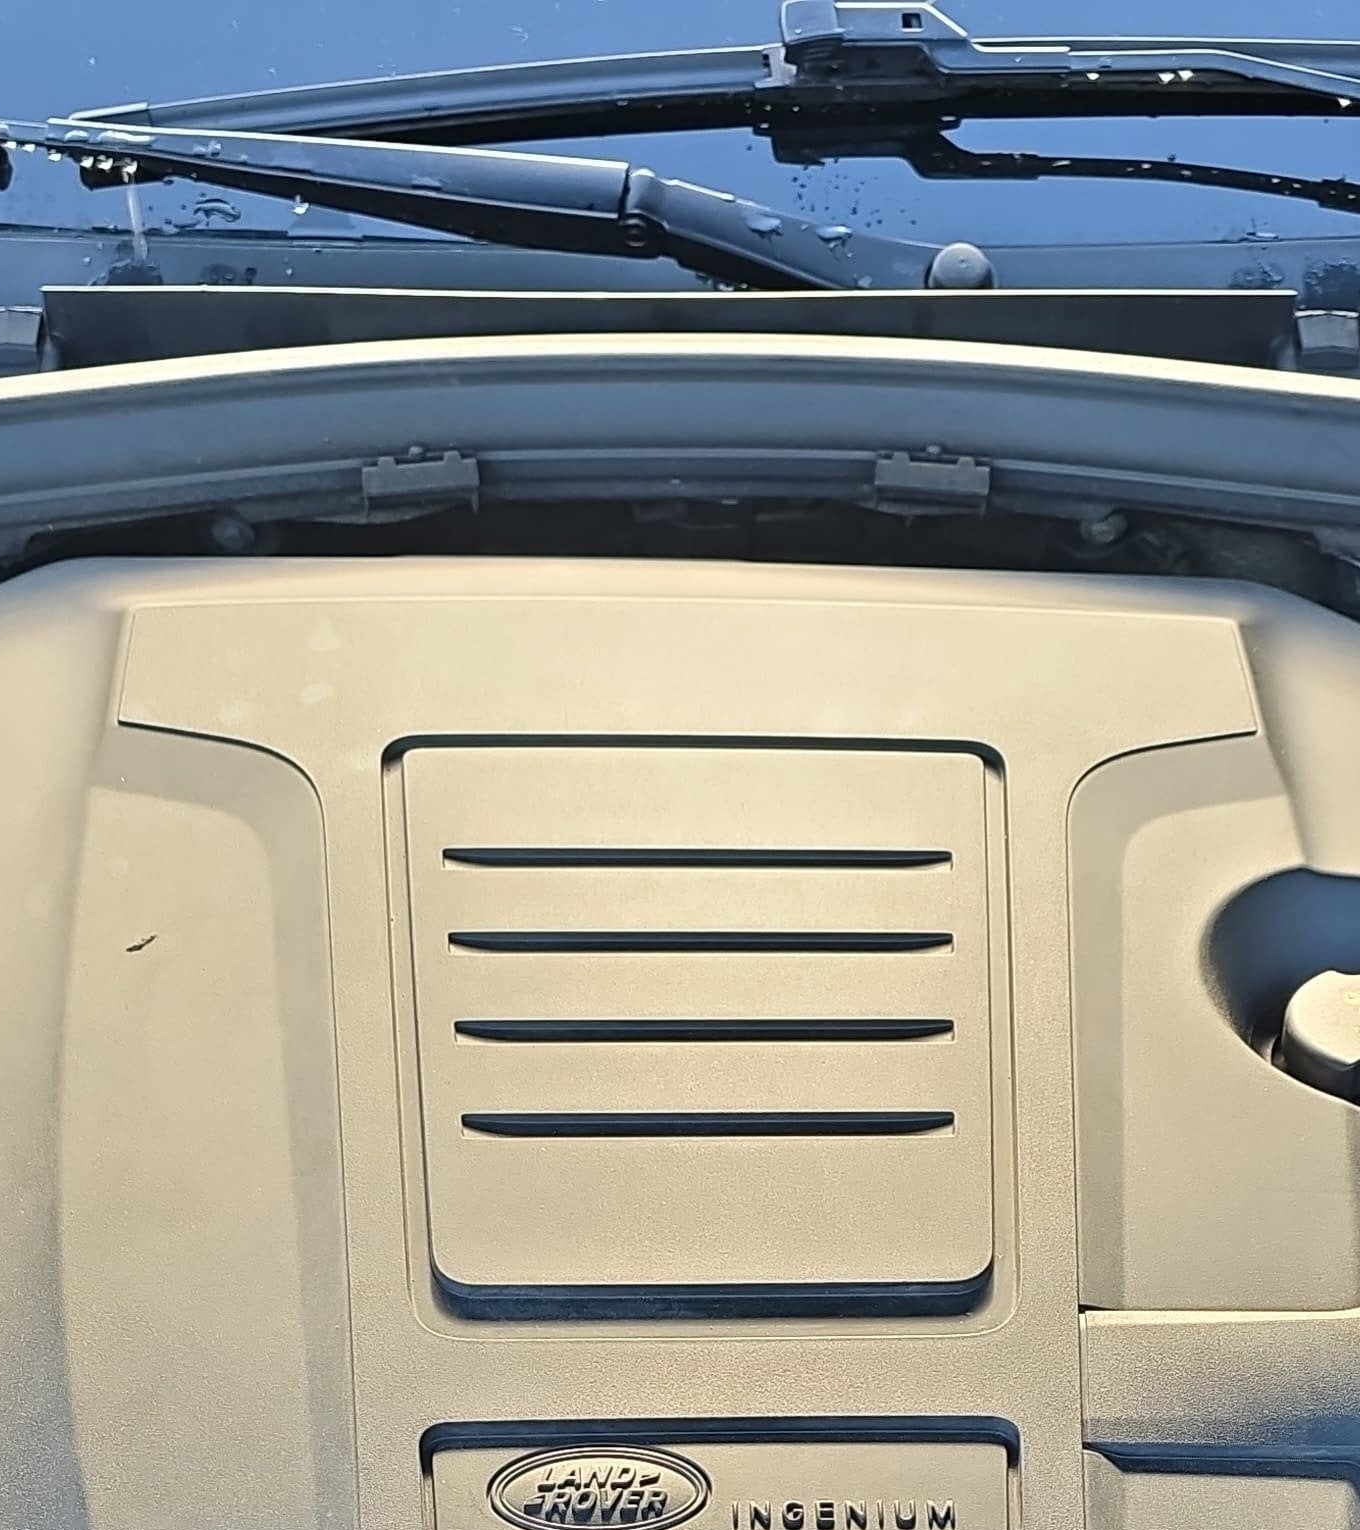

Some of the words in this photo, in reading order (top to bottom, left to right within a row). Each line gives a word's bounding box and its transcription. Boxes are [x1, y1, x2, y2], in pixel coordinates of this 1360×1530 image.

[537, 1465, 642, 1489] LAND
[543, 1489, 669, 1519] ROVER
[731, 1499, 958, 1530] INGENIUM
